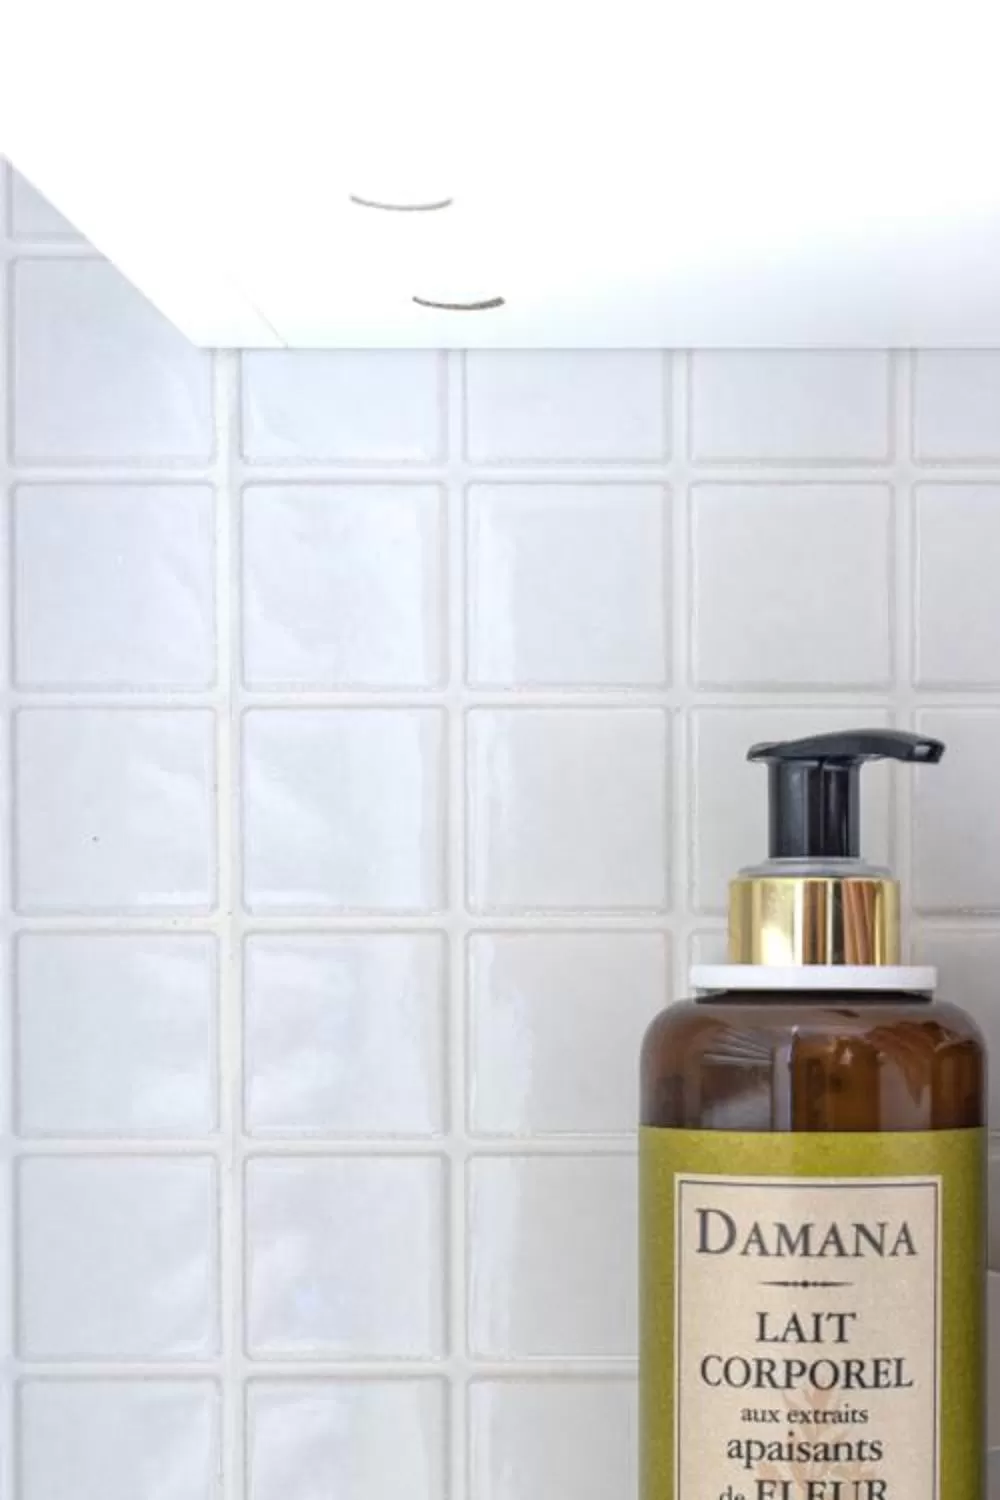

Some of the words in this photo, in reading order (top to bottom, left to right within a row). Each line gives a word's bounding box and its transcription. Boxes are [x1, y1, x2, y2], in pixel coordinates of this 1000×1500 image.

[694, 1207, 919, 1258] DAMANA
[755, 1312, 857, 1344] LAIT
[700, 1355, 914, 1391] CORPOREL
[740, 1407, 780, 1423] aux
[787, 1403, 869, 1425] extraits
[727, 1430, 883, 1469] apaisants
